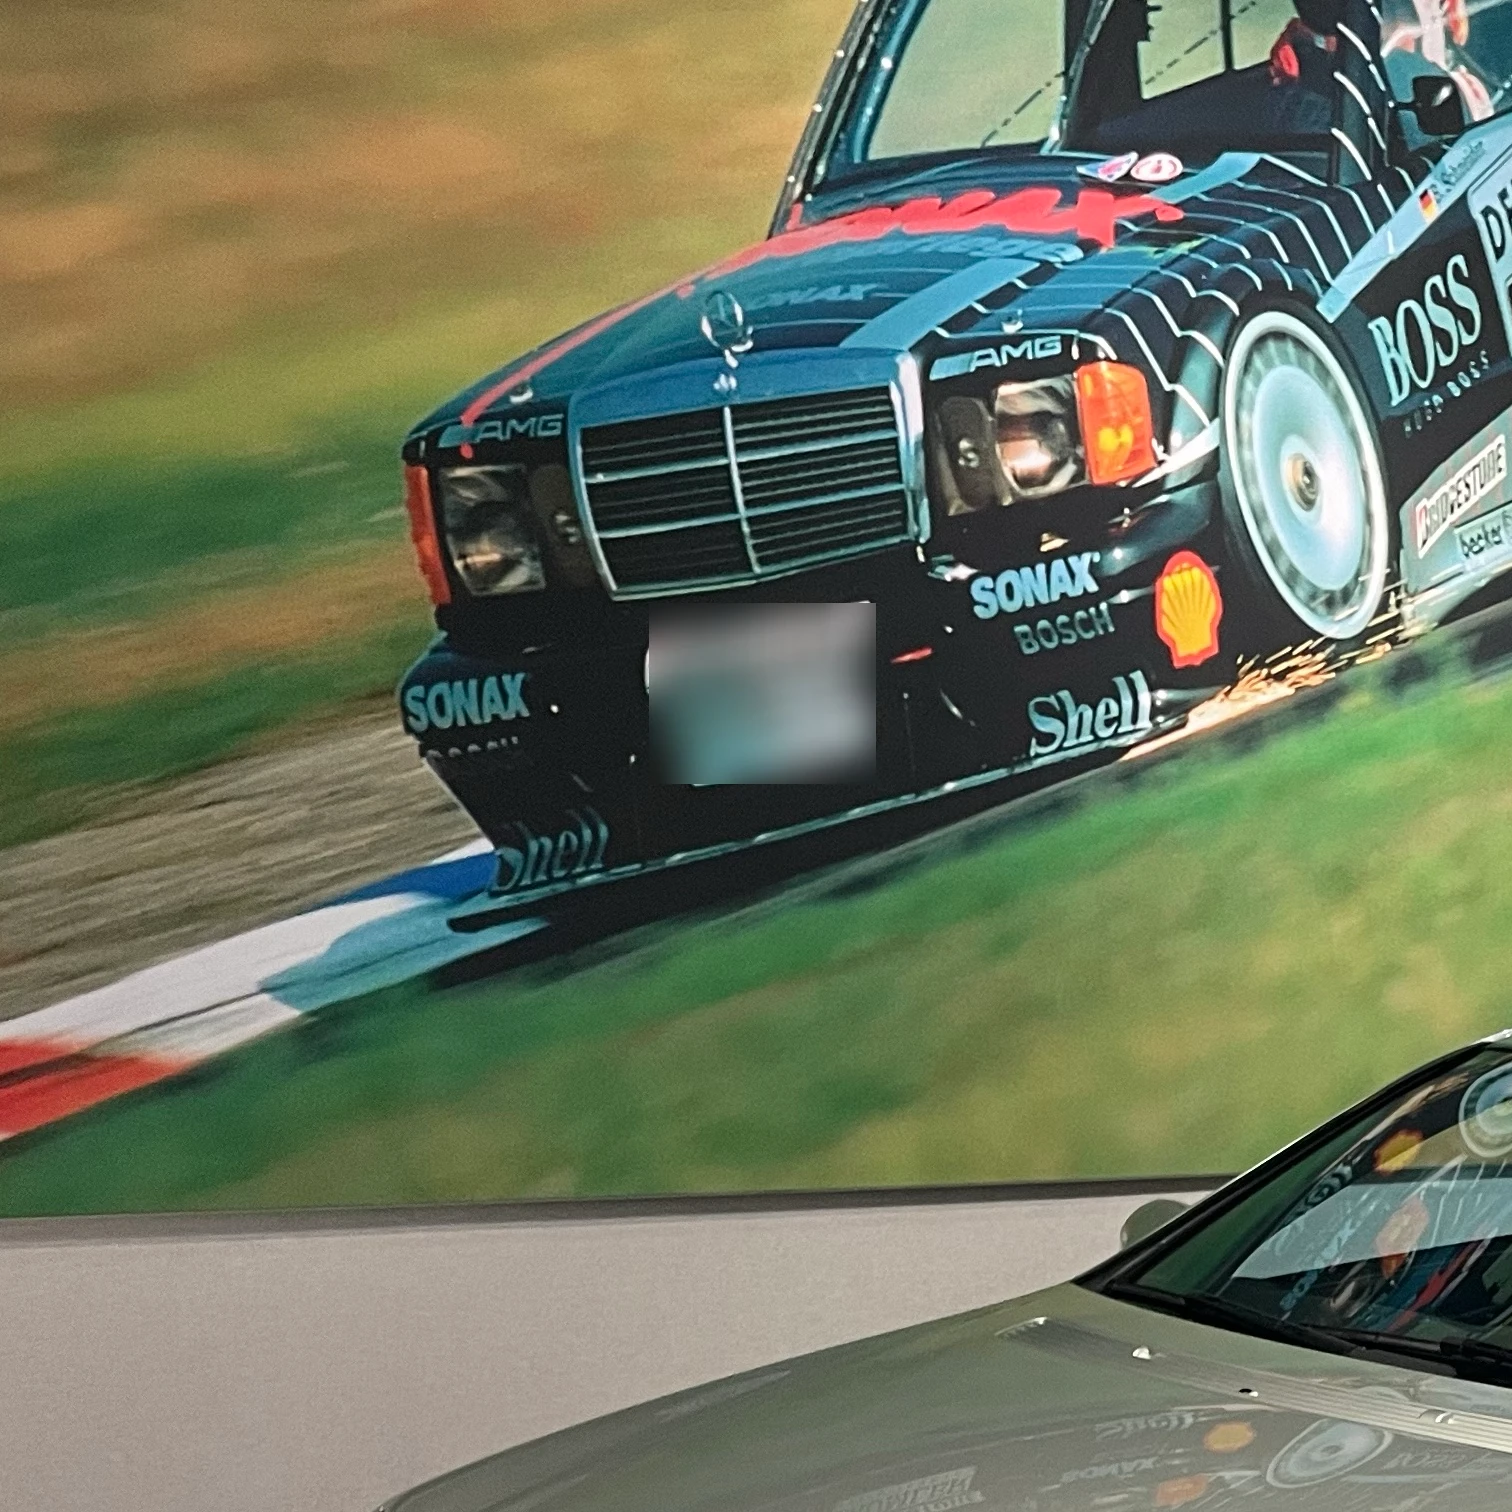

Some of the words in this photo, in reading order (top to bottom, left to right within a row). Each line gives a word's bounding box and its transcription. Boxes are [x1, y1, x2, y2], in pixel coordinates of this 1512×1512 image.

[967, 335, 1063, 374] AMG
[1367, 254, 1482, 408] BOSS
[474, 412, 565, 444] AMG
[1458, 522, 1503, 558] becker
[970, 551, 1100, 620] SONAX
[1012, 601, 1116, 655] BOSCH
[404, 671, 530, 733] SONAX
[1028, 669, 1153, 757] Shell
